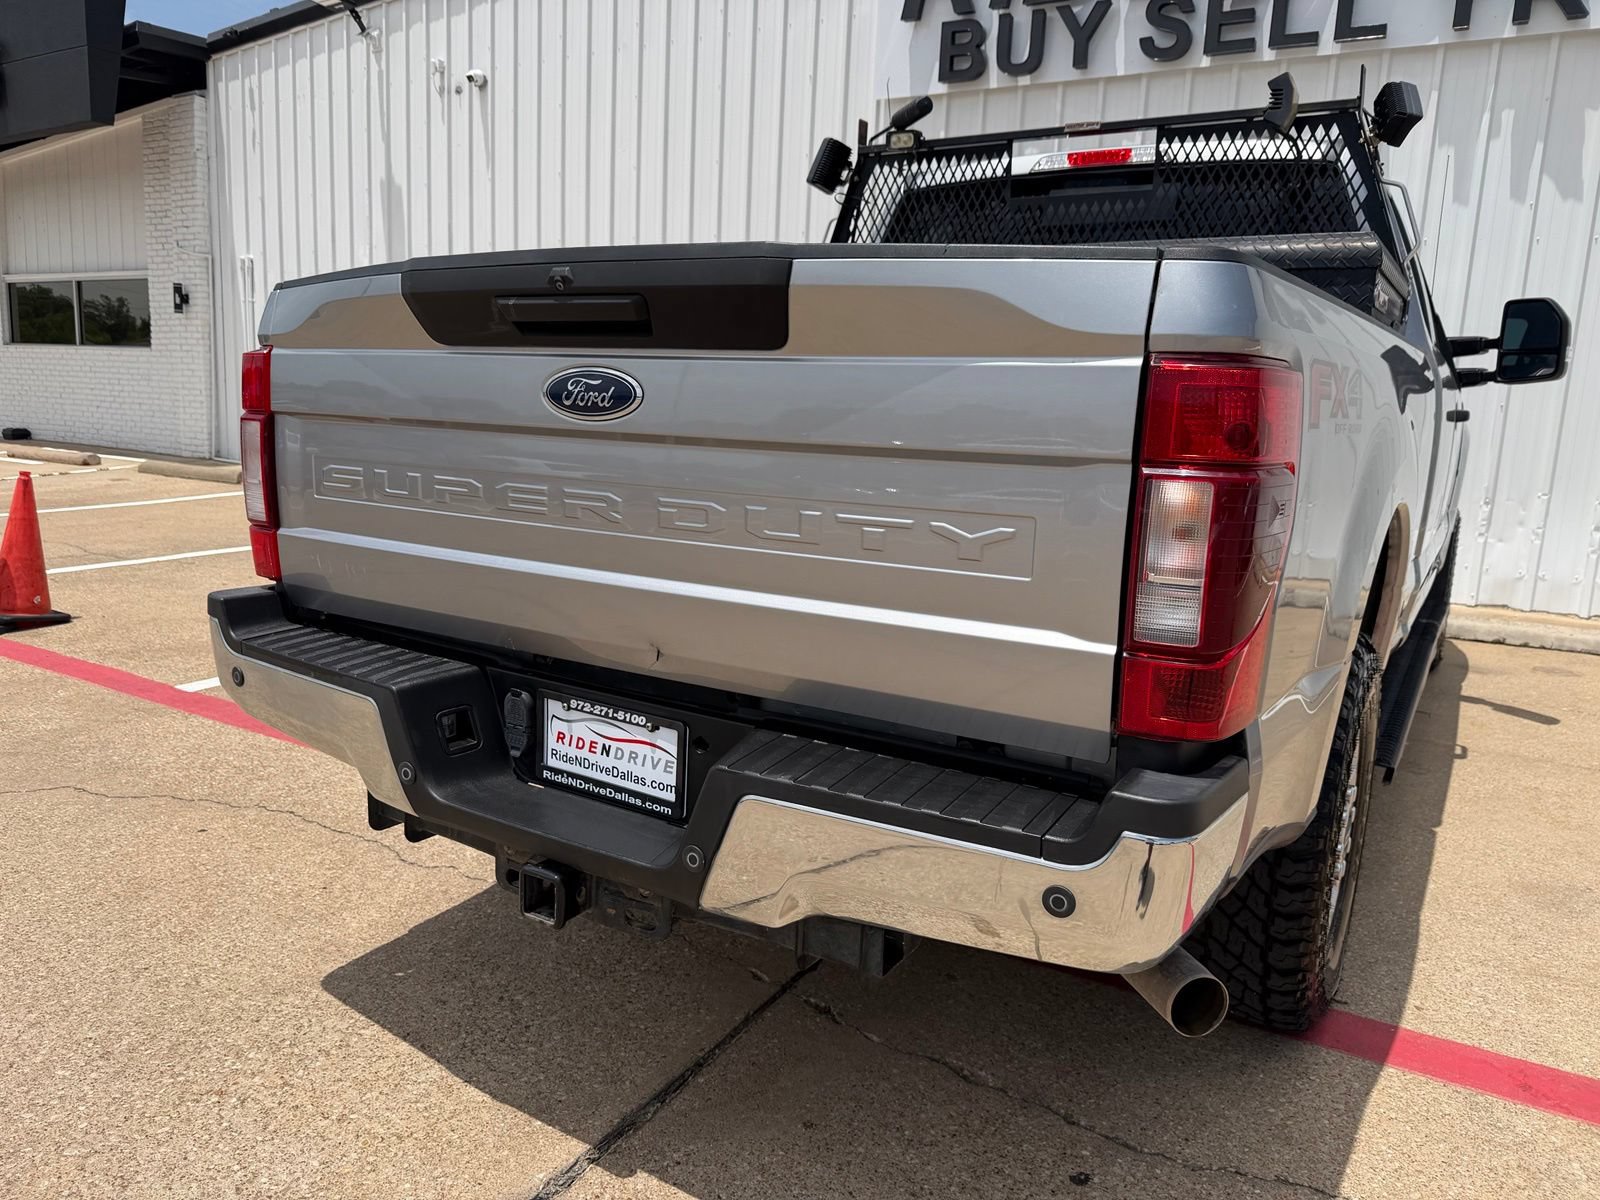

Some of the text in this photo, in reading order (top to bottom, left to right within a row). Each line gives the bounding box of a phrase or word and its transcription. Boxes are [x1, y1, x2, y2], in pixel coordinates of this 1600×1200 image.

[938, 0, 1113, 83] BUY
[1139, 0, 1388, 62] SELL
[561, 377, 614, 408] Ford
[1308, 359, 1362, 430] FX4
[321, 464, 1017, 562] SUPER DUTY
[569, 699, 647, 726] 972-271-5100
[550, 748, 677, 795] RideNDriveDallas.com
[555, 731, 676, 775] RIDENDRIVE
[542, 769, 672, 816] RideNDriveDallas.com
